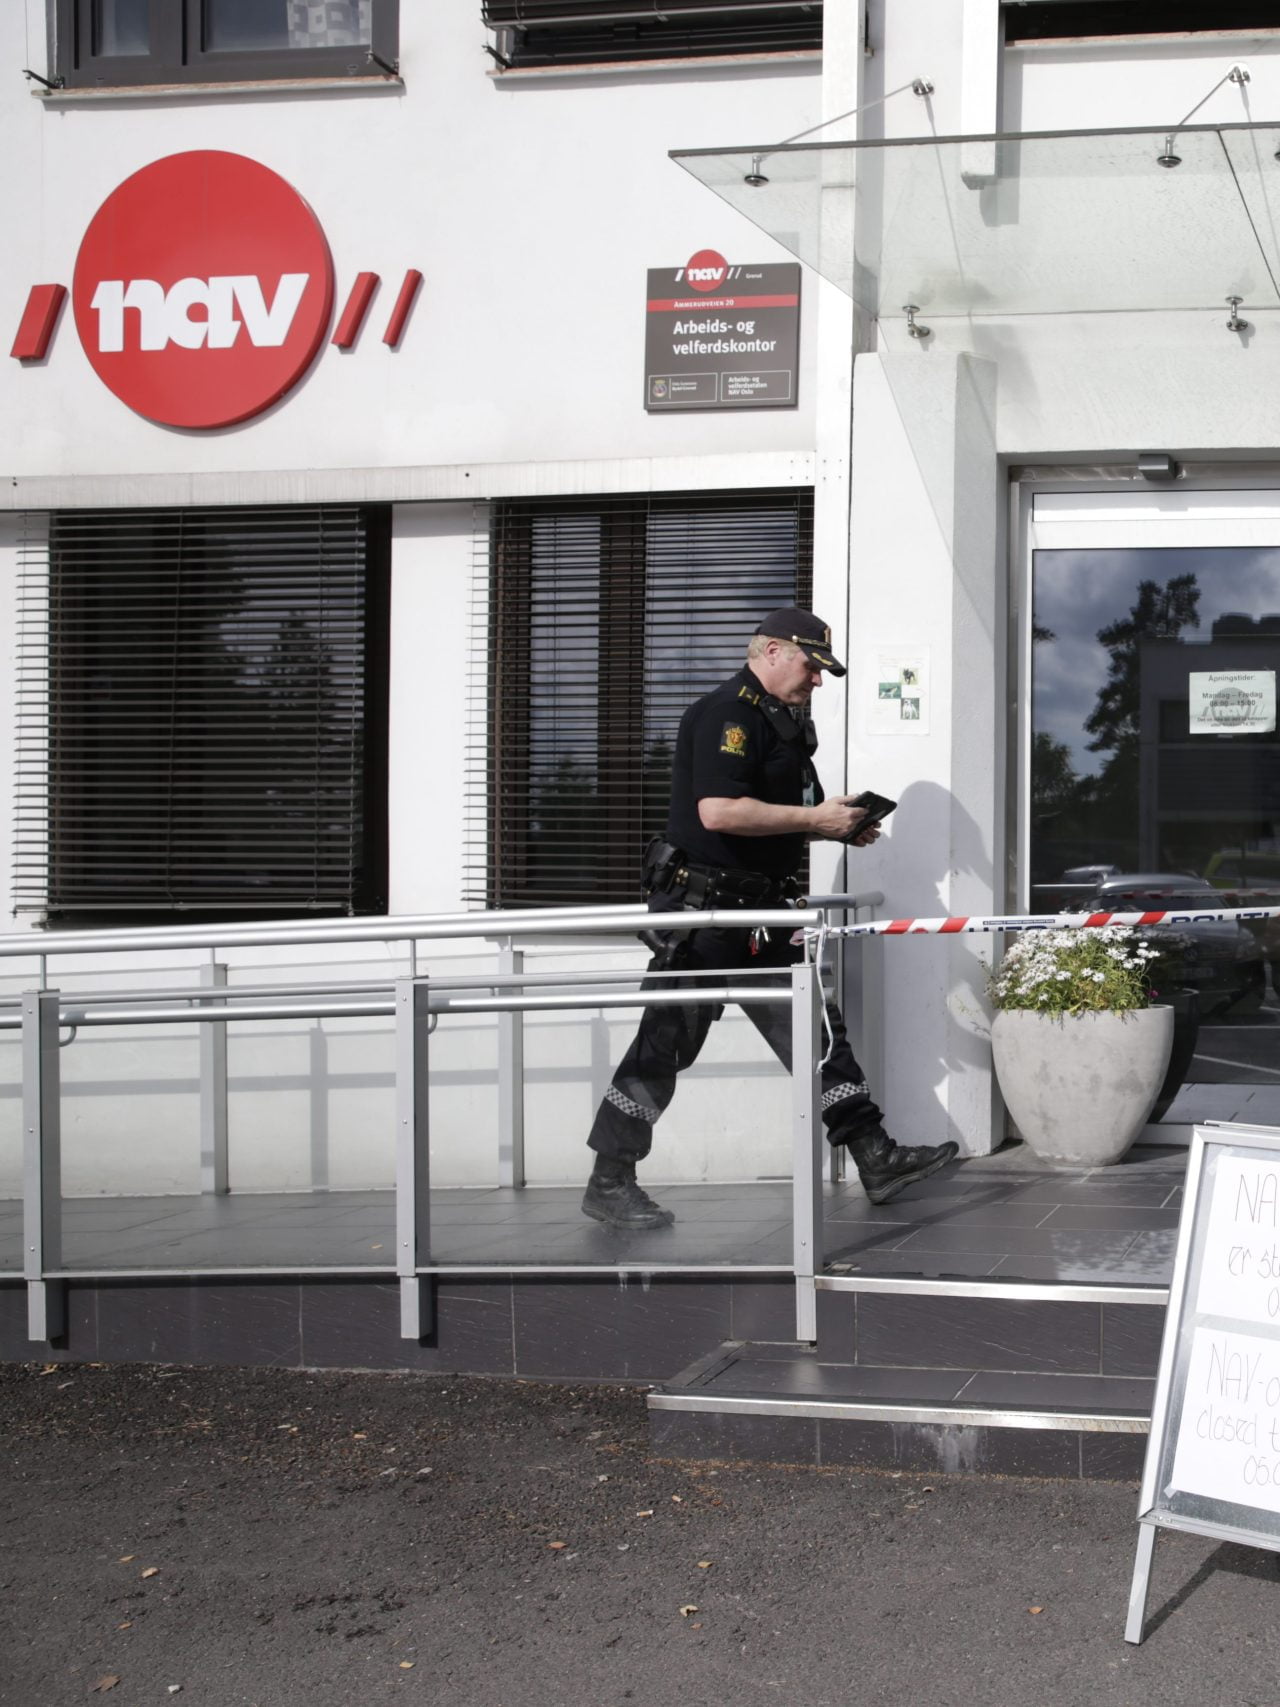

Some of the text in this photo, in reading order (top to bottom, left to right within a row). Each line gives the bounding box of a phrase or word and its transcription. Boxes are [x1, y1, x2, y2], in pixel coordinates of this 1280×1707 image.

[687, 267, 724, 281] nav
[90, 273, 310, 353] nav
[673, 319, 756, 335] Arbeids- og
[673, 338, 777, 355] velferdskontor
[1228, 1245, 1252, 1276] er
[1196, 1404, 1258, 1448] closed
